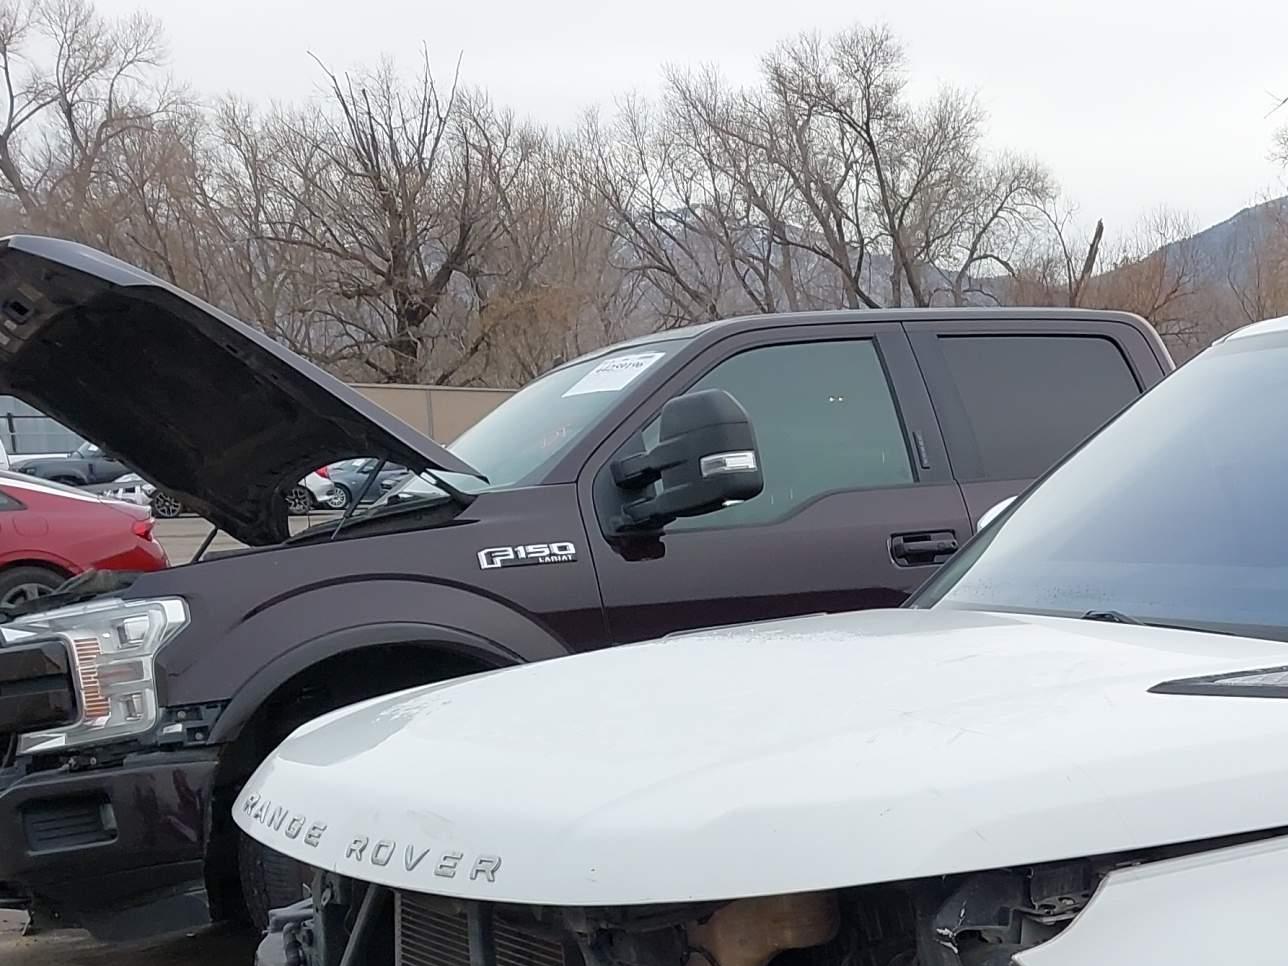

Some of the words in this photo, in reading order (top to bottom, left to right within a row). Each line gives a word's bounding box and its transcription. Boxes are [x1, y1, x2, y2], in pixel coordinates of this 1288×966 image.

[477, 542, 576, 570] F150
[538, 554, 573, 563] LARIAT
[242, 792, 328, 847] RANGE
[345, 834, 503, 883] ROVER
